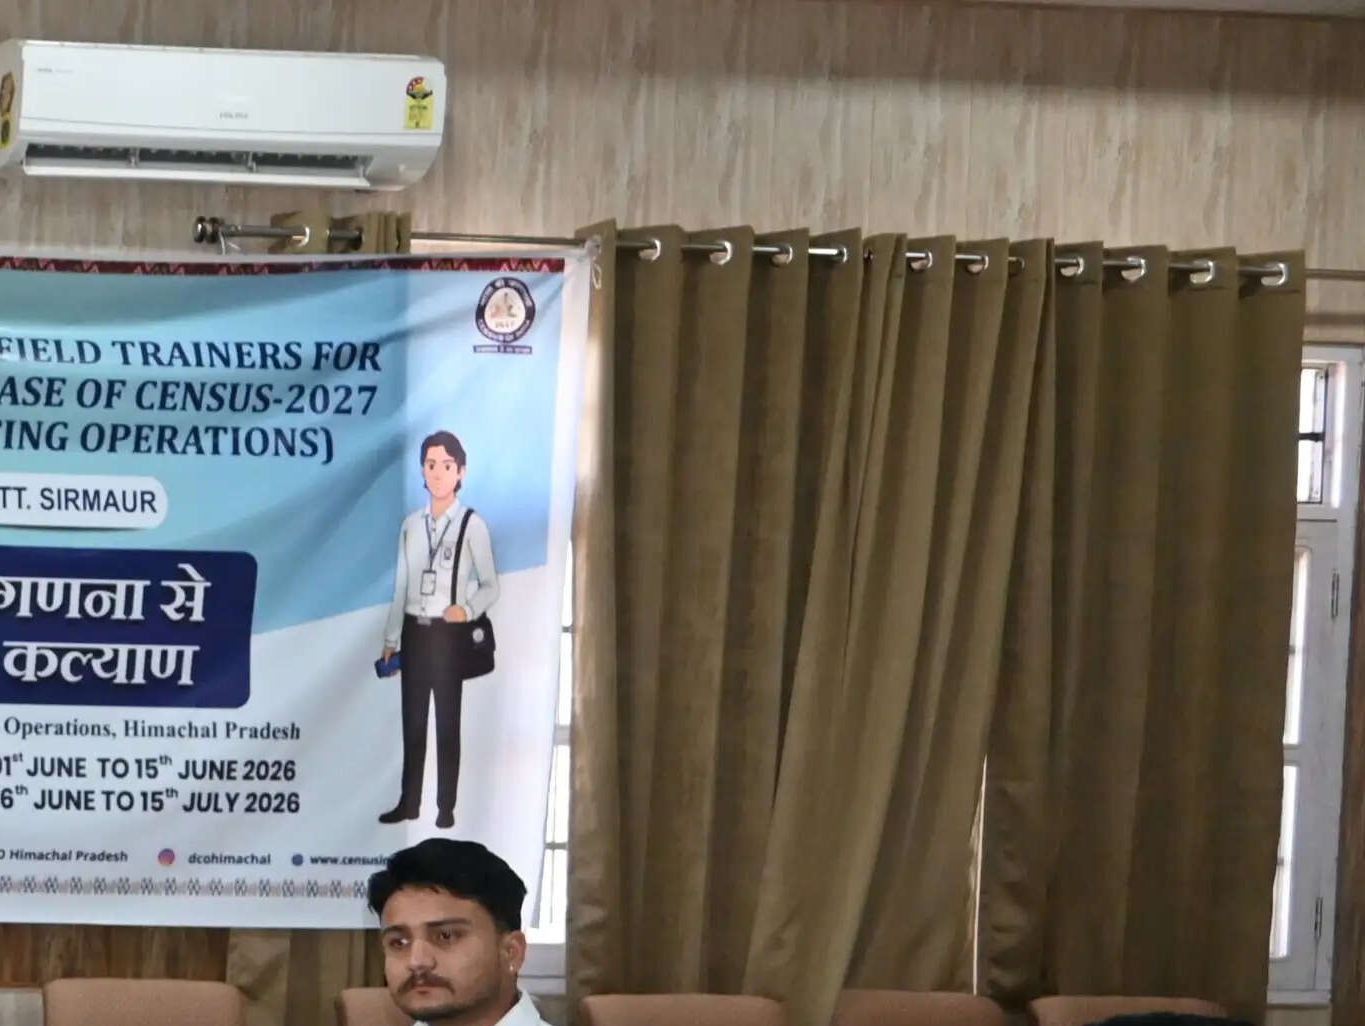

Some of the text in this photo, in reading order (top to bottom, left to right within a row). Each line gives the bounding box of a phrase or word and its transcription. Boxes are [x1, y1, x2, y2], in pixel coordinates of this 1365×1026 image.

[111, 338, 303, 370] TRAINERS
[311, 341, 382, 372] FOR
[75, 377, 127, 409] OF
[135, 380, 378, 416] CENSUS-2027
[80, 421, 334, 466] OPERATIONS)
[40, 487, 158, 513] SIRMAUR
[159, 563, 212, 622] से
[2, 640, 201, 686] कल्याण
[4, 716, 118, 740] Operations,
[123, 719, 218, 738] Himachal
[224, 721, 301, 740] Pradesh
[26, 756, 87, 778] JUNE
[97, 757, 129, 779] TO
[177, 760, 238, 781] JUNE
[242, 760, 297, 781] 2026
[33, 789, 96, 811] JUNE
[101, 790, 135, 812] TO
[182, 791, 241, 813] JULY
[244, 792, 301, 814] 2026
[9, 849, 72, 862] Himachal
[75, 850, 128, 862] Pradesh
[188, 852, 271, 865] dcohimachal
